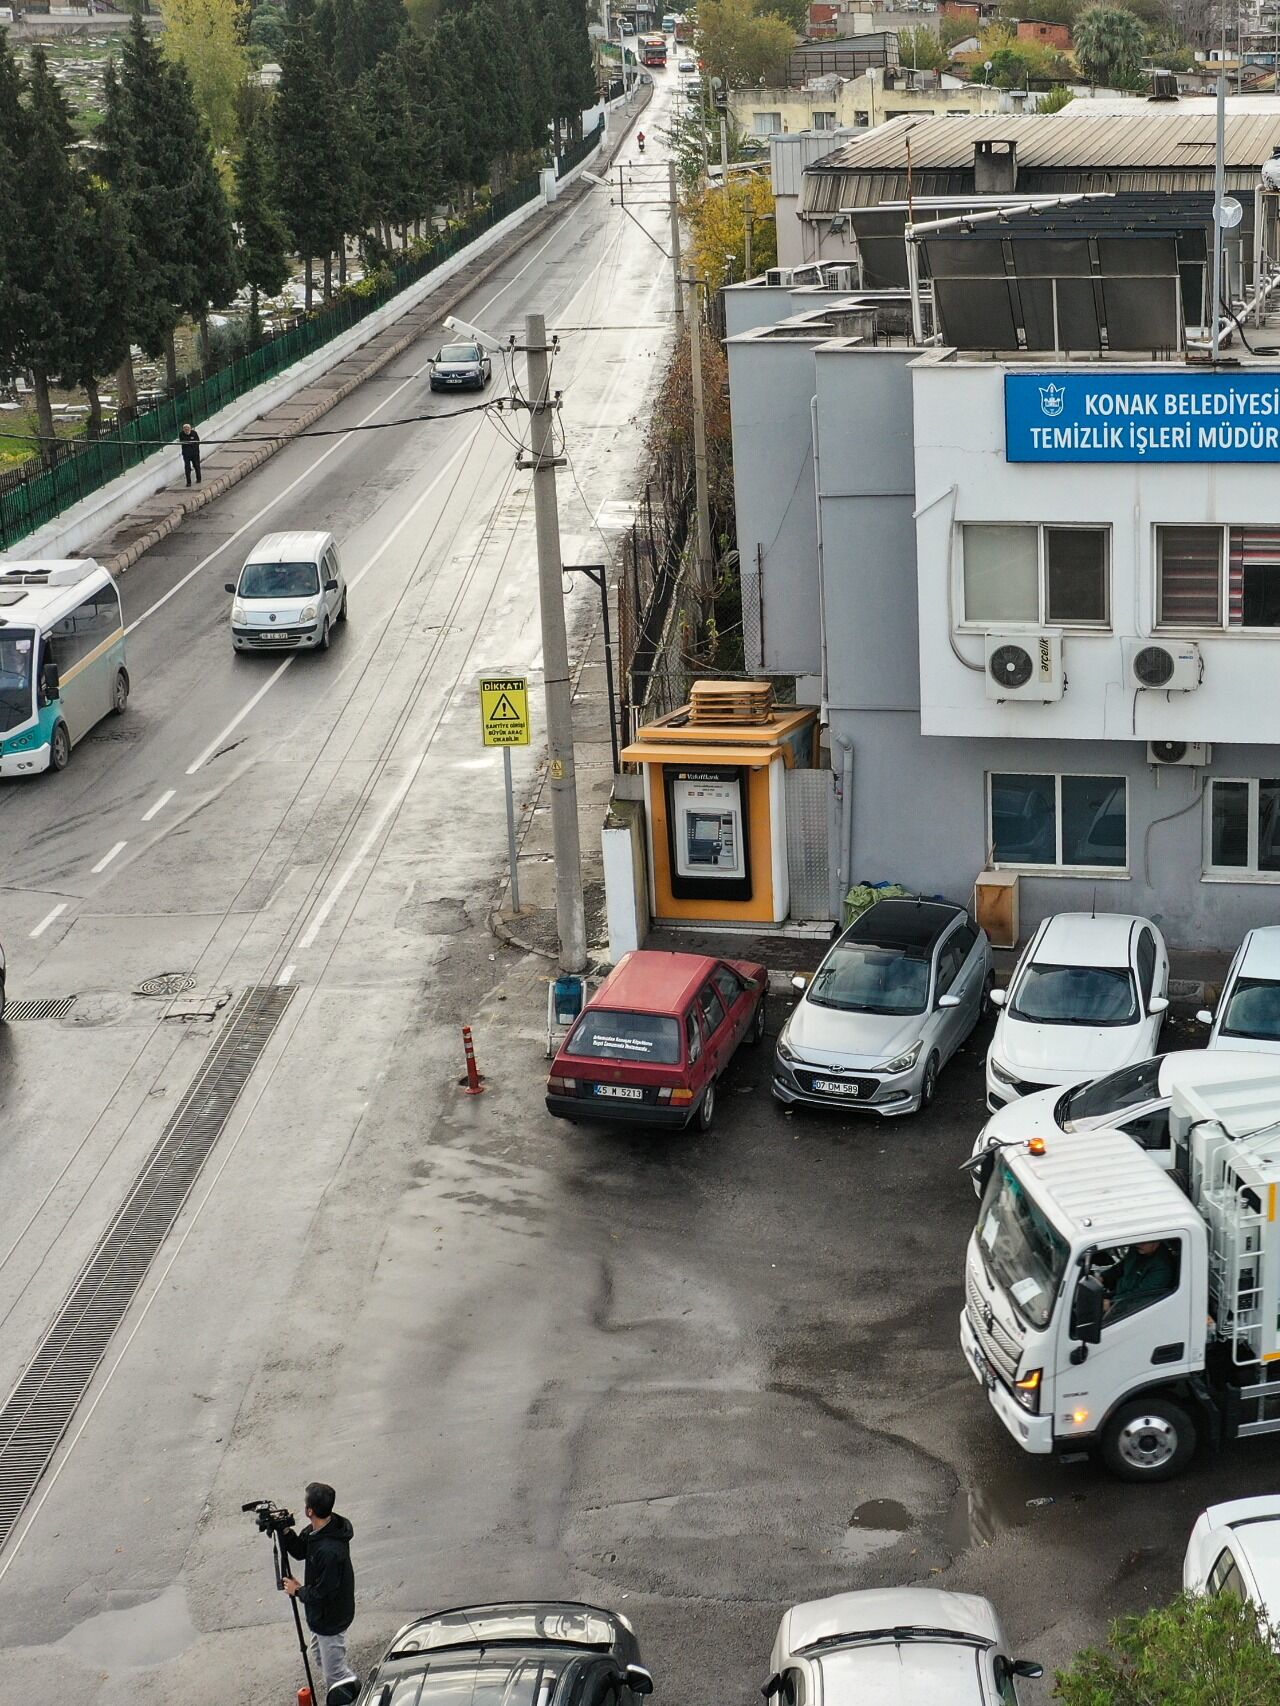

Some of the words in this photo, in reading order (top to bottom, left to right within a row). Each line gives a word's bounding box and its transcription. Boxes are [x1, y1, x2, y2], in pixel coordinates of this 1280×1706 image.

[1085, 393, 1158, 415] KONAK
[1165, 388, 1280, 415] BELEDİYESİ
[1030, 422, 1123, 449] TEMİZLİK
[1129, 421, 1191, 454] İŞLERİ
[1040, 638, 1050, 672] arçelik
[597, 1085, 608, 1094] 45
[621, 1087, 641, 1098] 5213
[816, 1081, 825, 1089] 07
[828, 1083, 840, 1091] DM
[843, 1084, 858, 1093] 589
